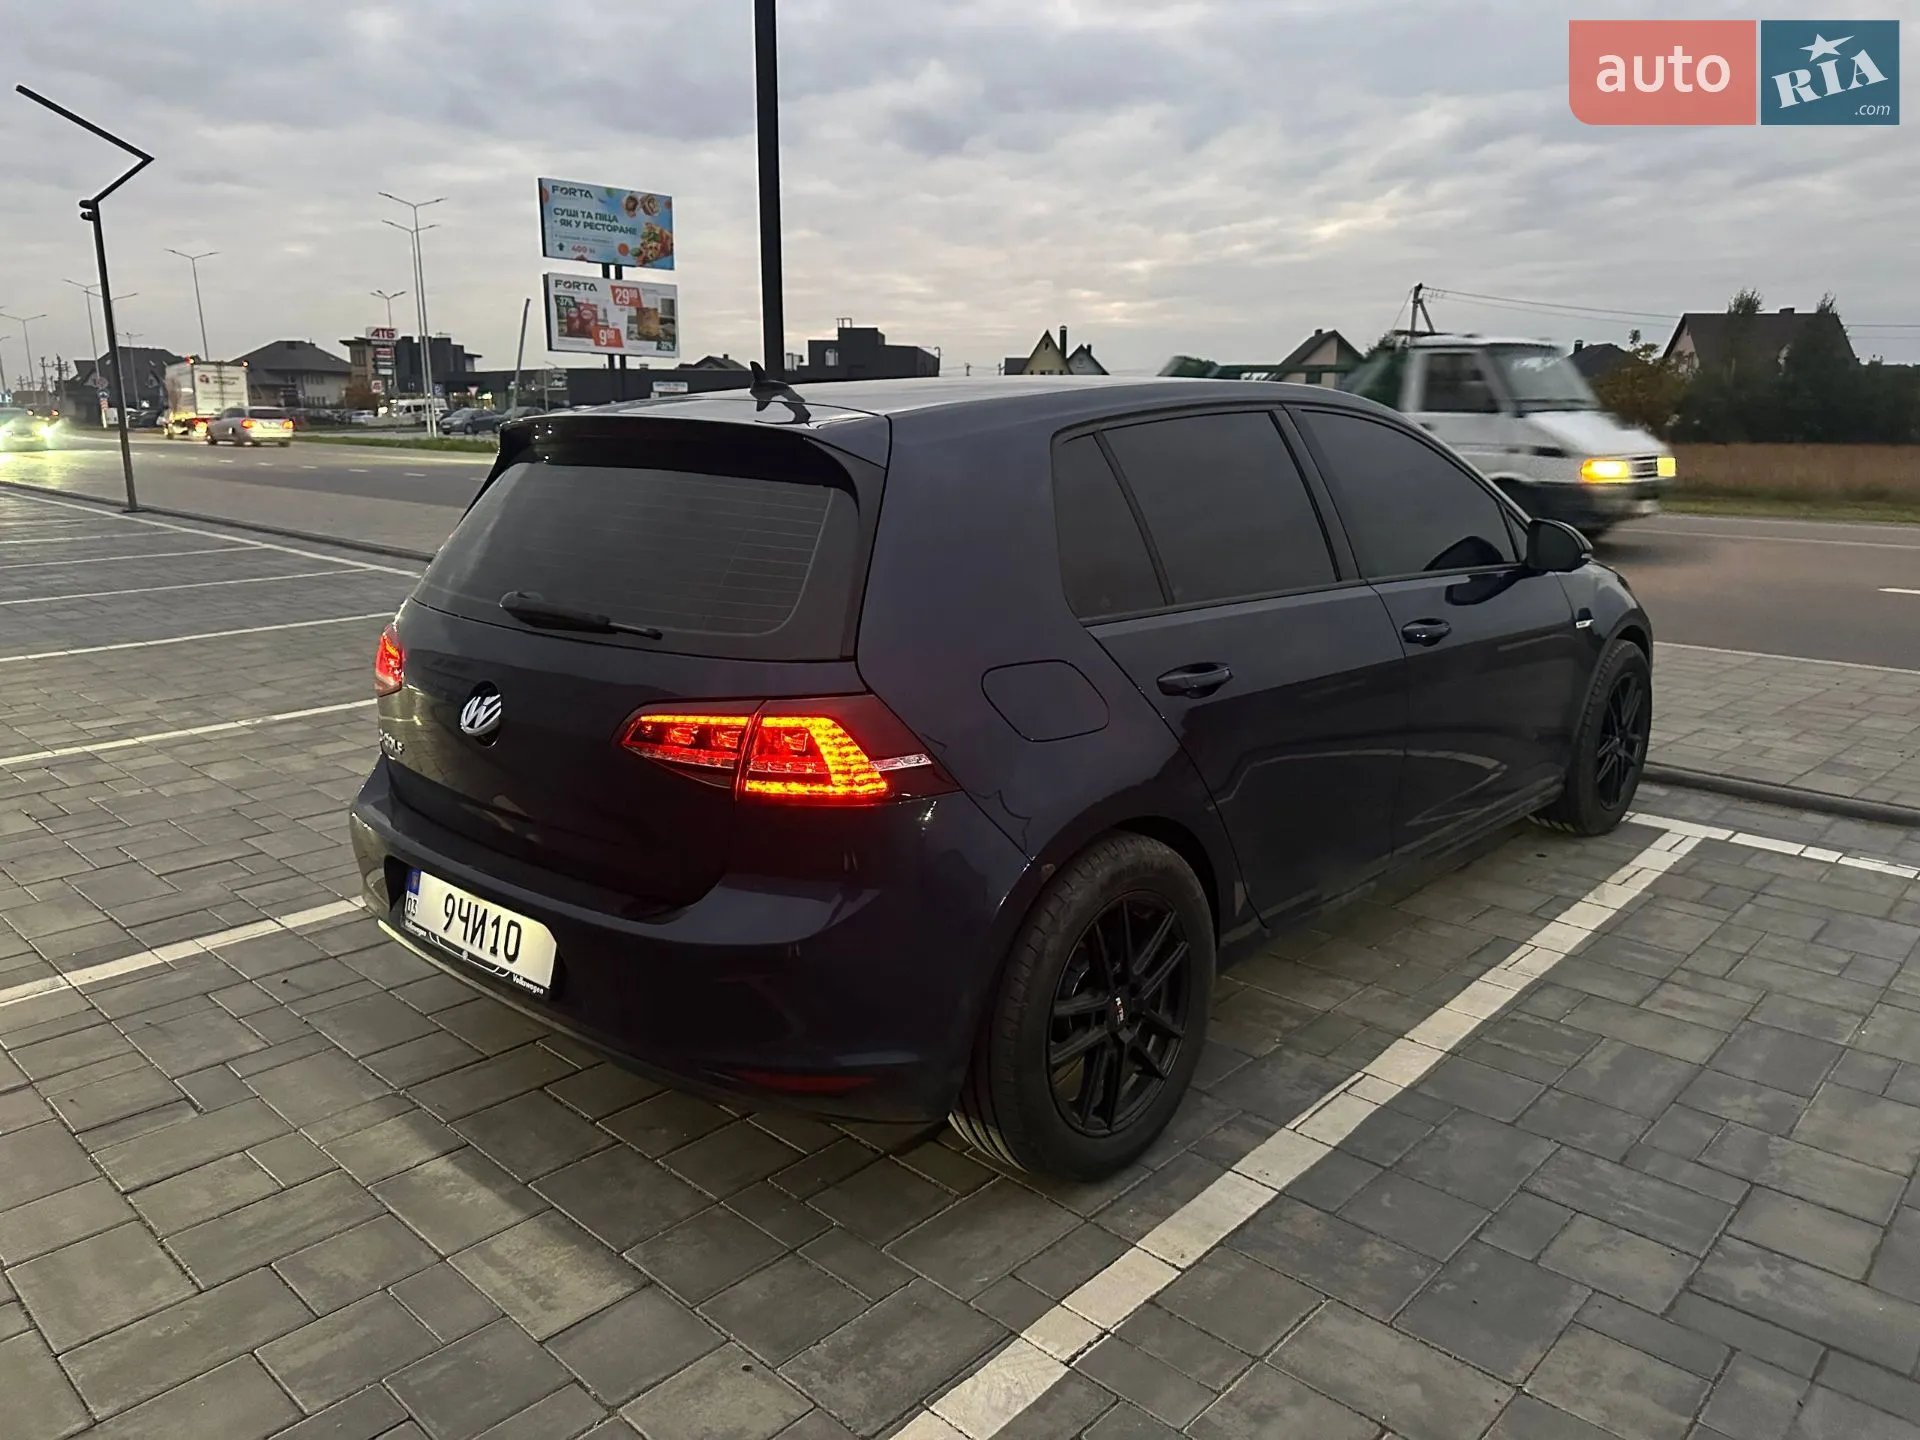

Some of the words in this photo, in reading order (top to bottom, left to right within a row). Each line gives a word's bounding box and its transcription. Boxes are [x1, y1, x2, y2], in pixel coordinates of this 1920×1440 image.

[551, 185, 593, 200] FORTA
[580, 210, 593, 220] ТА
[555, 279, 598, 292] FORTA
[615, 288, 630, 304] 29
[599, 329, 607, 345] 9
[512, 973, 544, 995] Volkswagen
